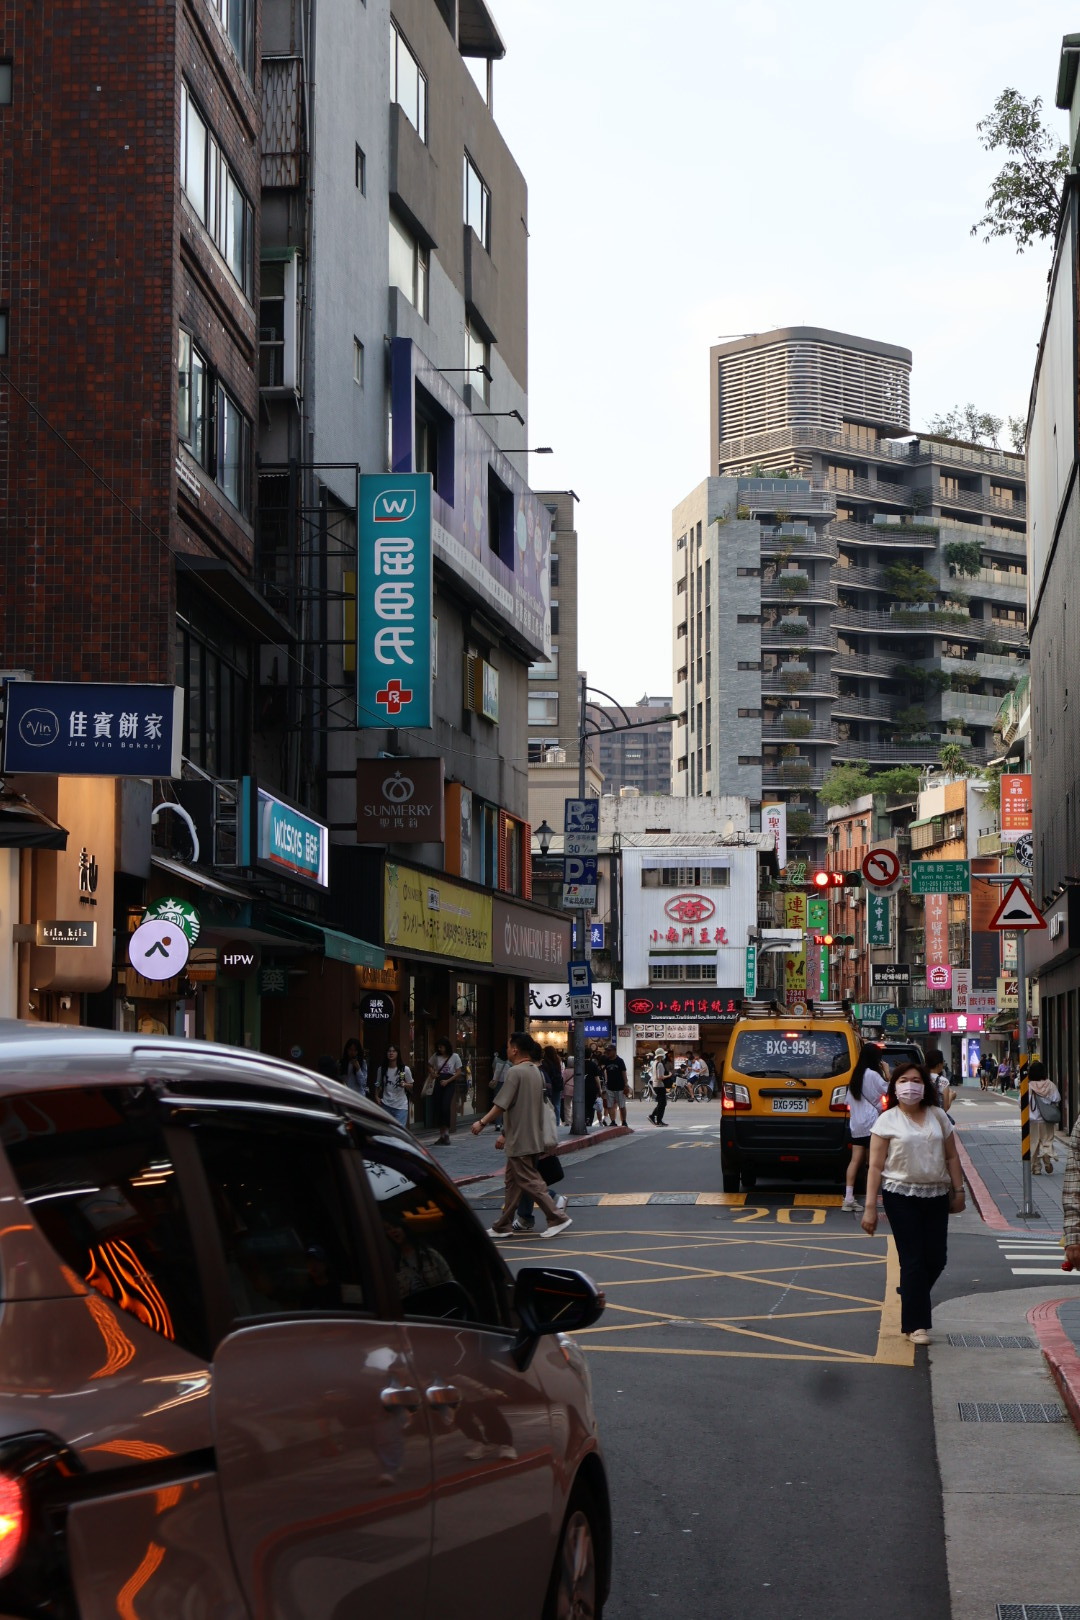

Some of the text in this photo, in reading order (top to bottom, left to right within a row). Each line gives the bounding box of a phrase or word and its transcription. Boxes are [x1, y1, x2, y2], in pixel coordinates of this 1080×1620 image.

[374, 537, 415, 665] 屈臣氏
[69, 711, 164, 740] 佳賓餅家
[121, 742, 162, 750] Bakery
[363, 804, 433, 817] SUNMERRY
[565, 858, 584, 883] P
[917, 864, 964, 872] 信義路二段
[43, 927, 87, 937] kila kila
[650, 926, 729, 944] 小南門豆花
[512, 923, 544, 960] SUNMERRY
[223, 955, 254, 965] HPW
[262, 969, 284, 992] 藥
[957, 972, 967, 1006] 三槍牌
[529, 989, 602, 1009] 武田肉
[656, 1000, 737, 1013] 小南門傳統豆
[969, 997, 996, 1006] 旅行箱
[766, 1040, 817, 1055] BXG-9531
[729, 1207, 827, 1225] 20
